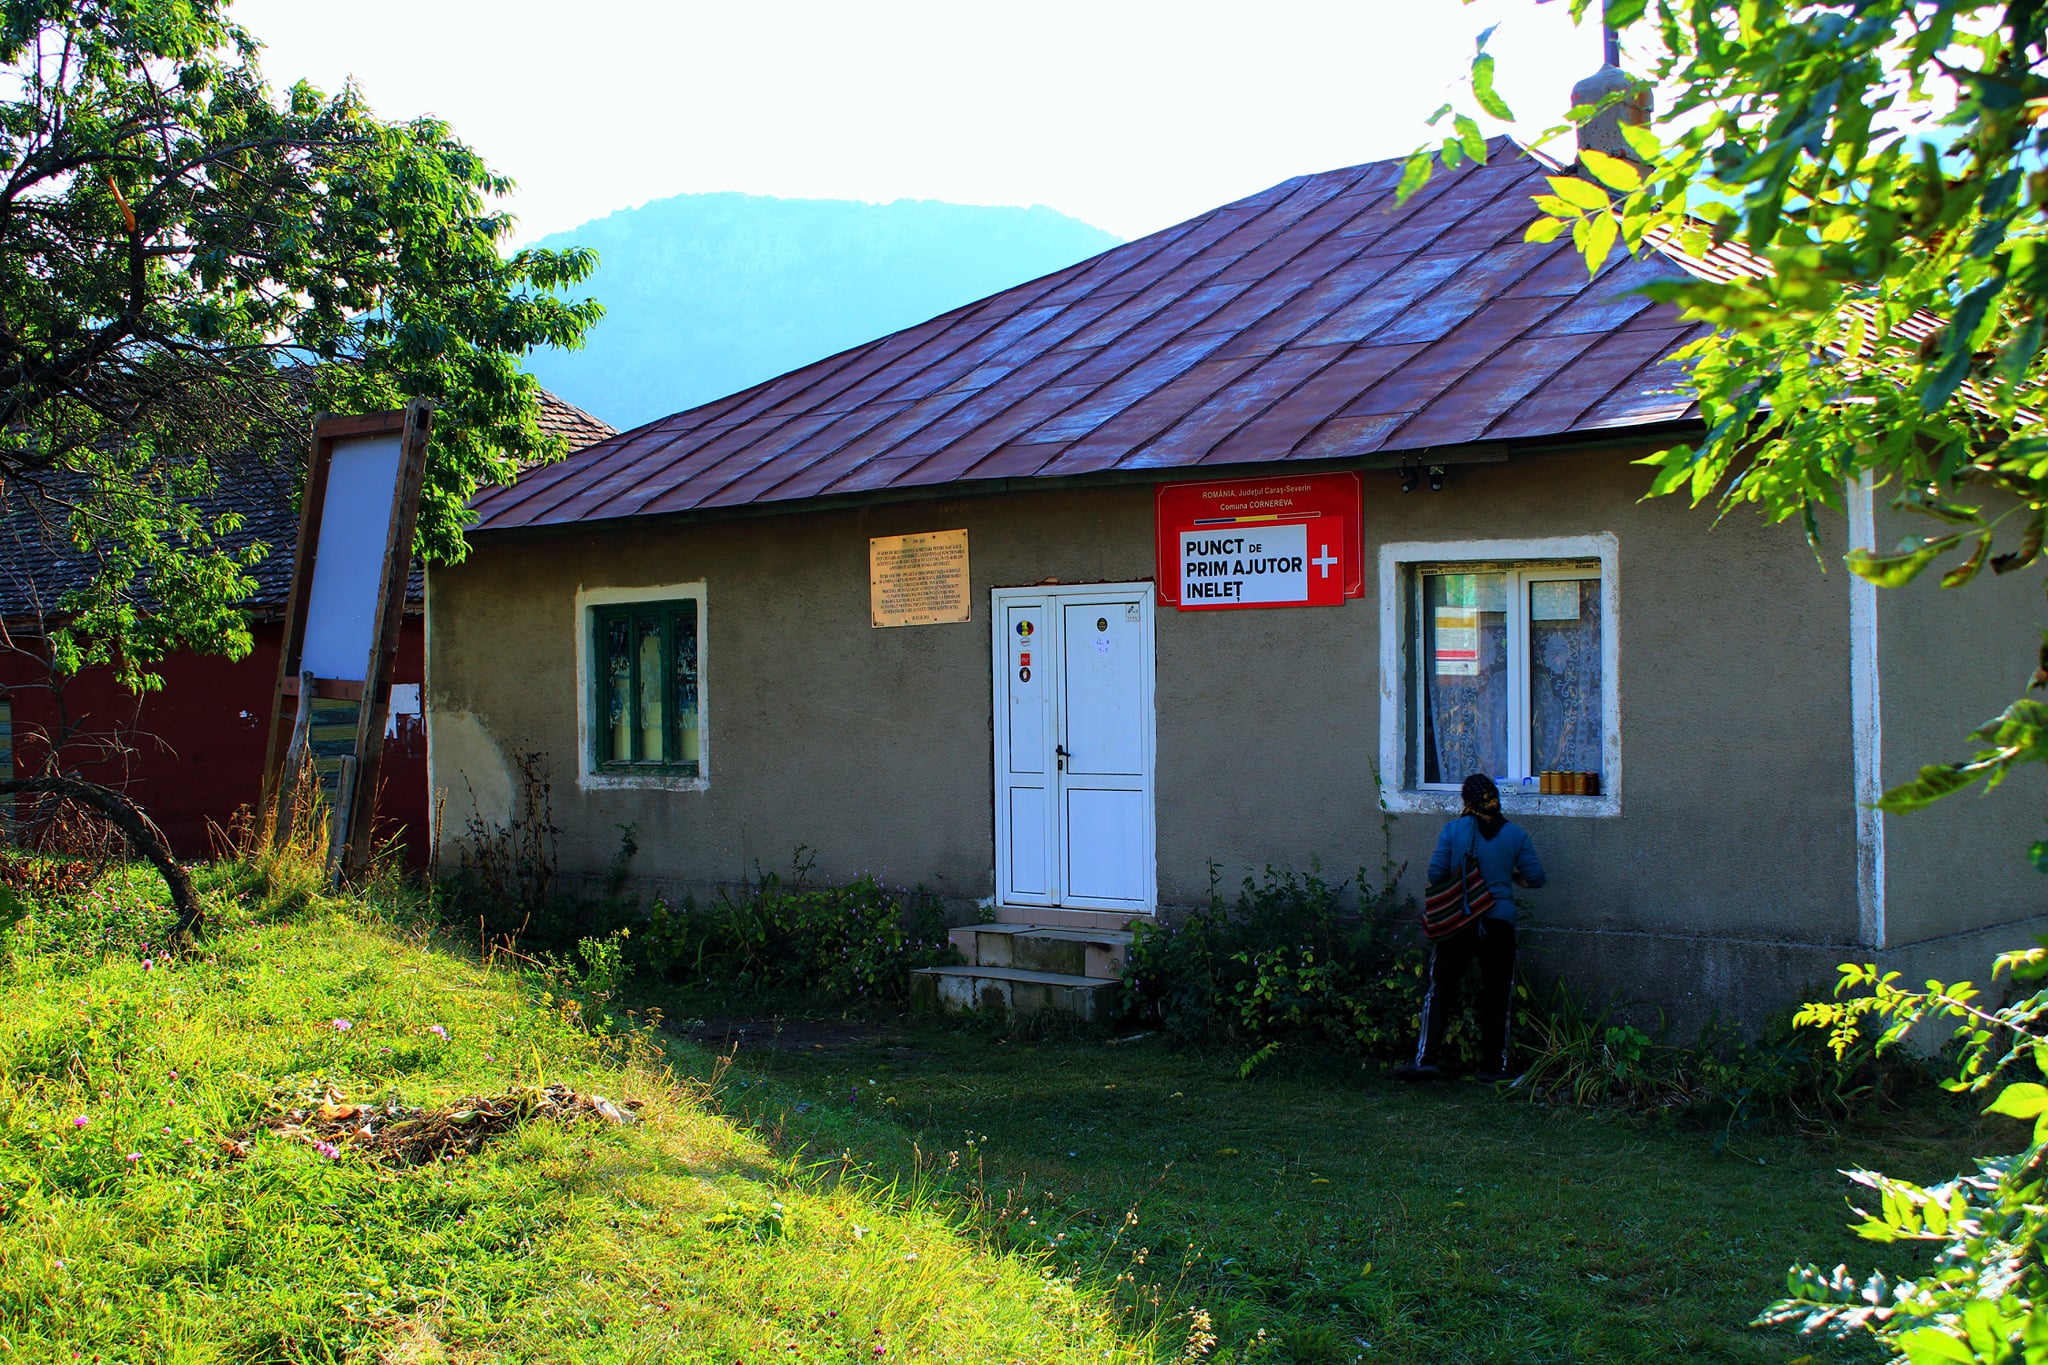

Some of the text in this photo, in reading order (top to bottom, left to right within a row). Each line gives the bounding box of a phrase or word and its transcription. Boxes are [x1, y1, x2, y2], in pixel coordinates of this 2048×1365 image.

[1220, 499, 1293, 511] Comuna CORNEREVA
[1186, 538, 1262, 557] PUNCT DE
[1186, 557, 1303, 578] PRIM AJUTOR
[1186, 581, 1243, 602] INELEȚ
